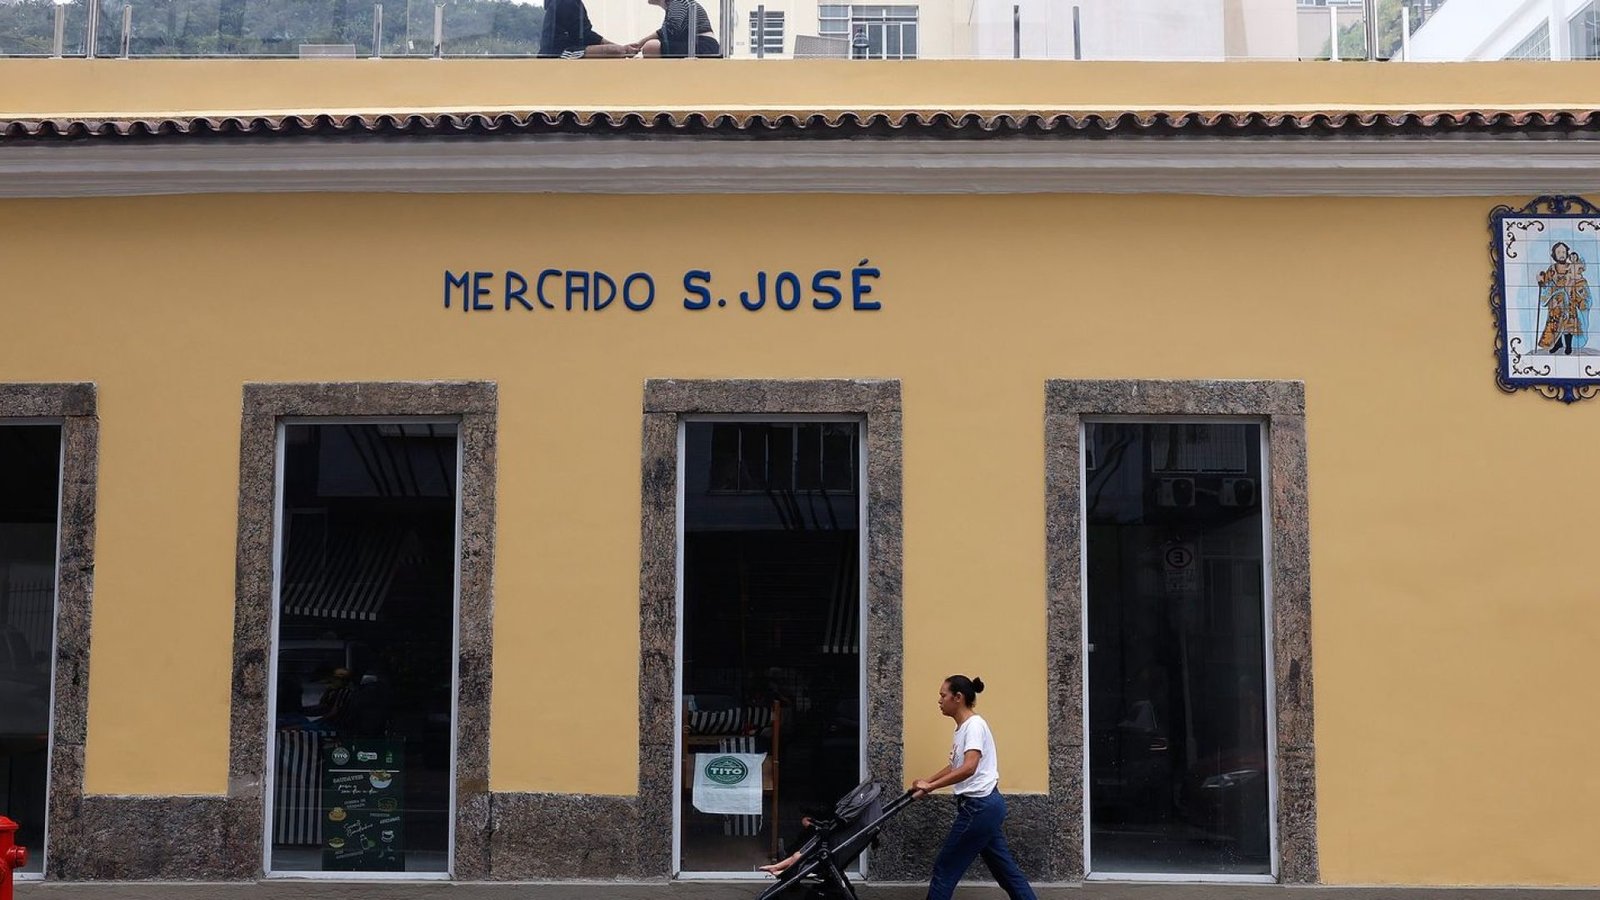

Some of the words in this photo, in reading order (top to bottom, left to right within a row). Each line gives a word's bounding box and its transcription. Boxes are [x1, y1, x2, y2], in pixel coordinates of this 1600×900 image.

[445, 269, 655, 312] MERCADO
[684, 270, 728, 310] S.
[741, 259, 881, 311] JOSÉ
[710, 767, 742, 775] TITO
